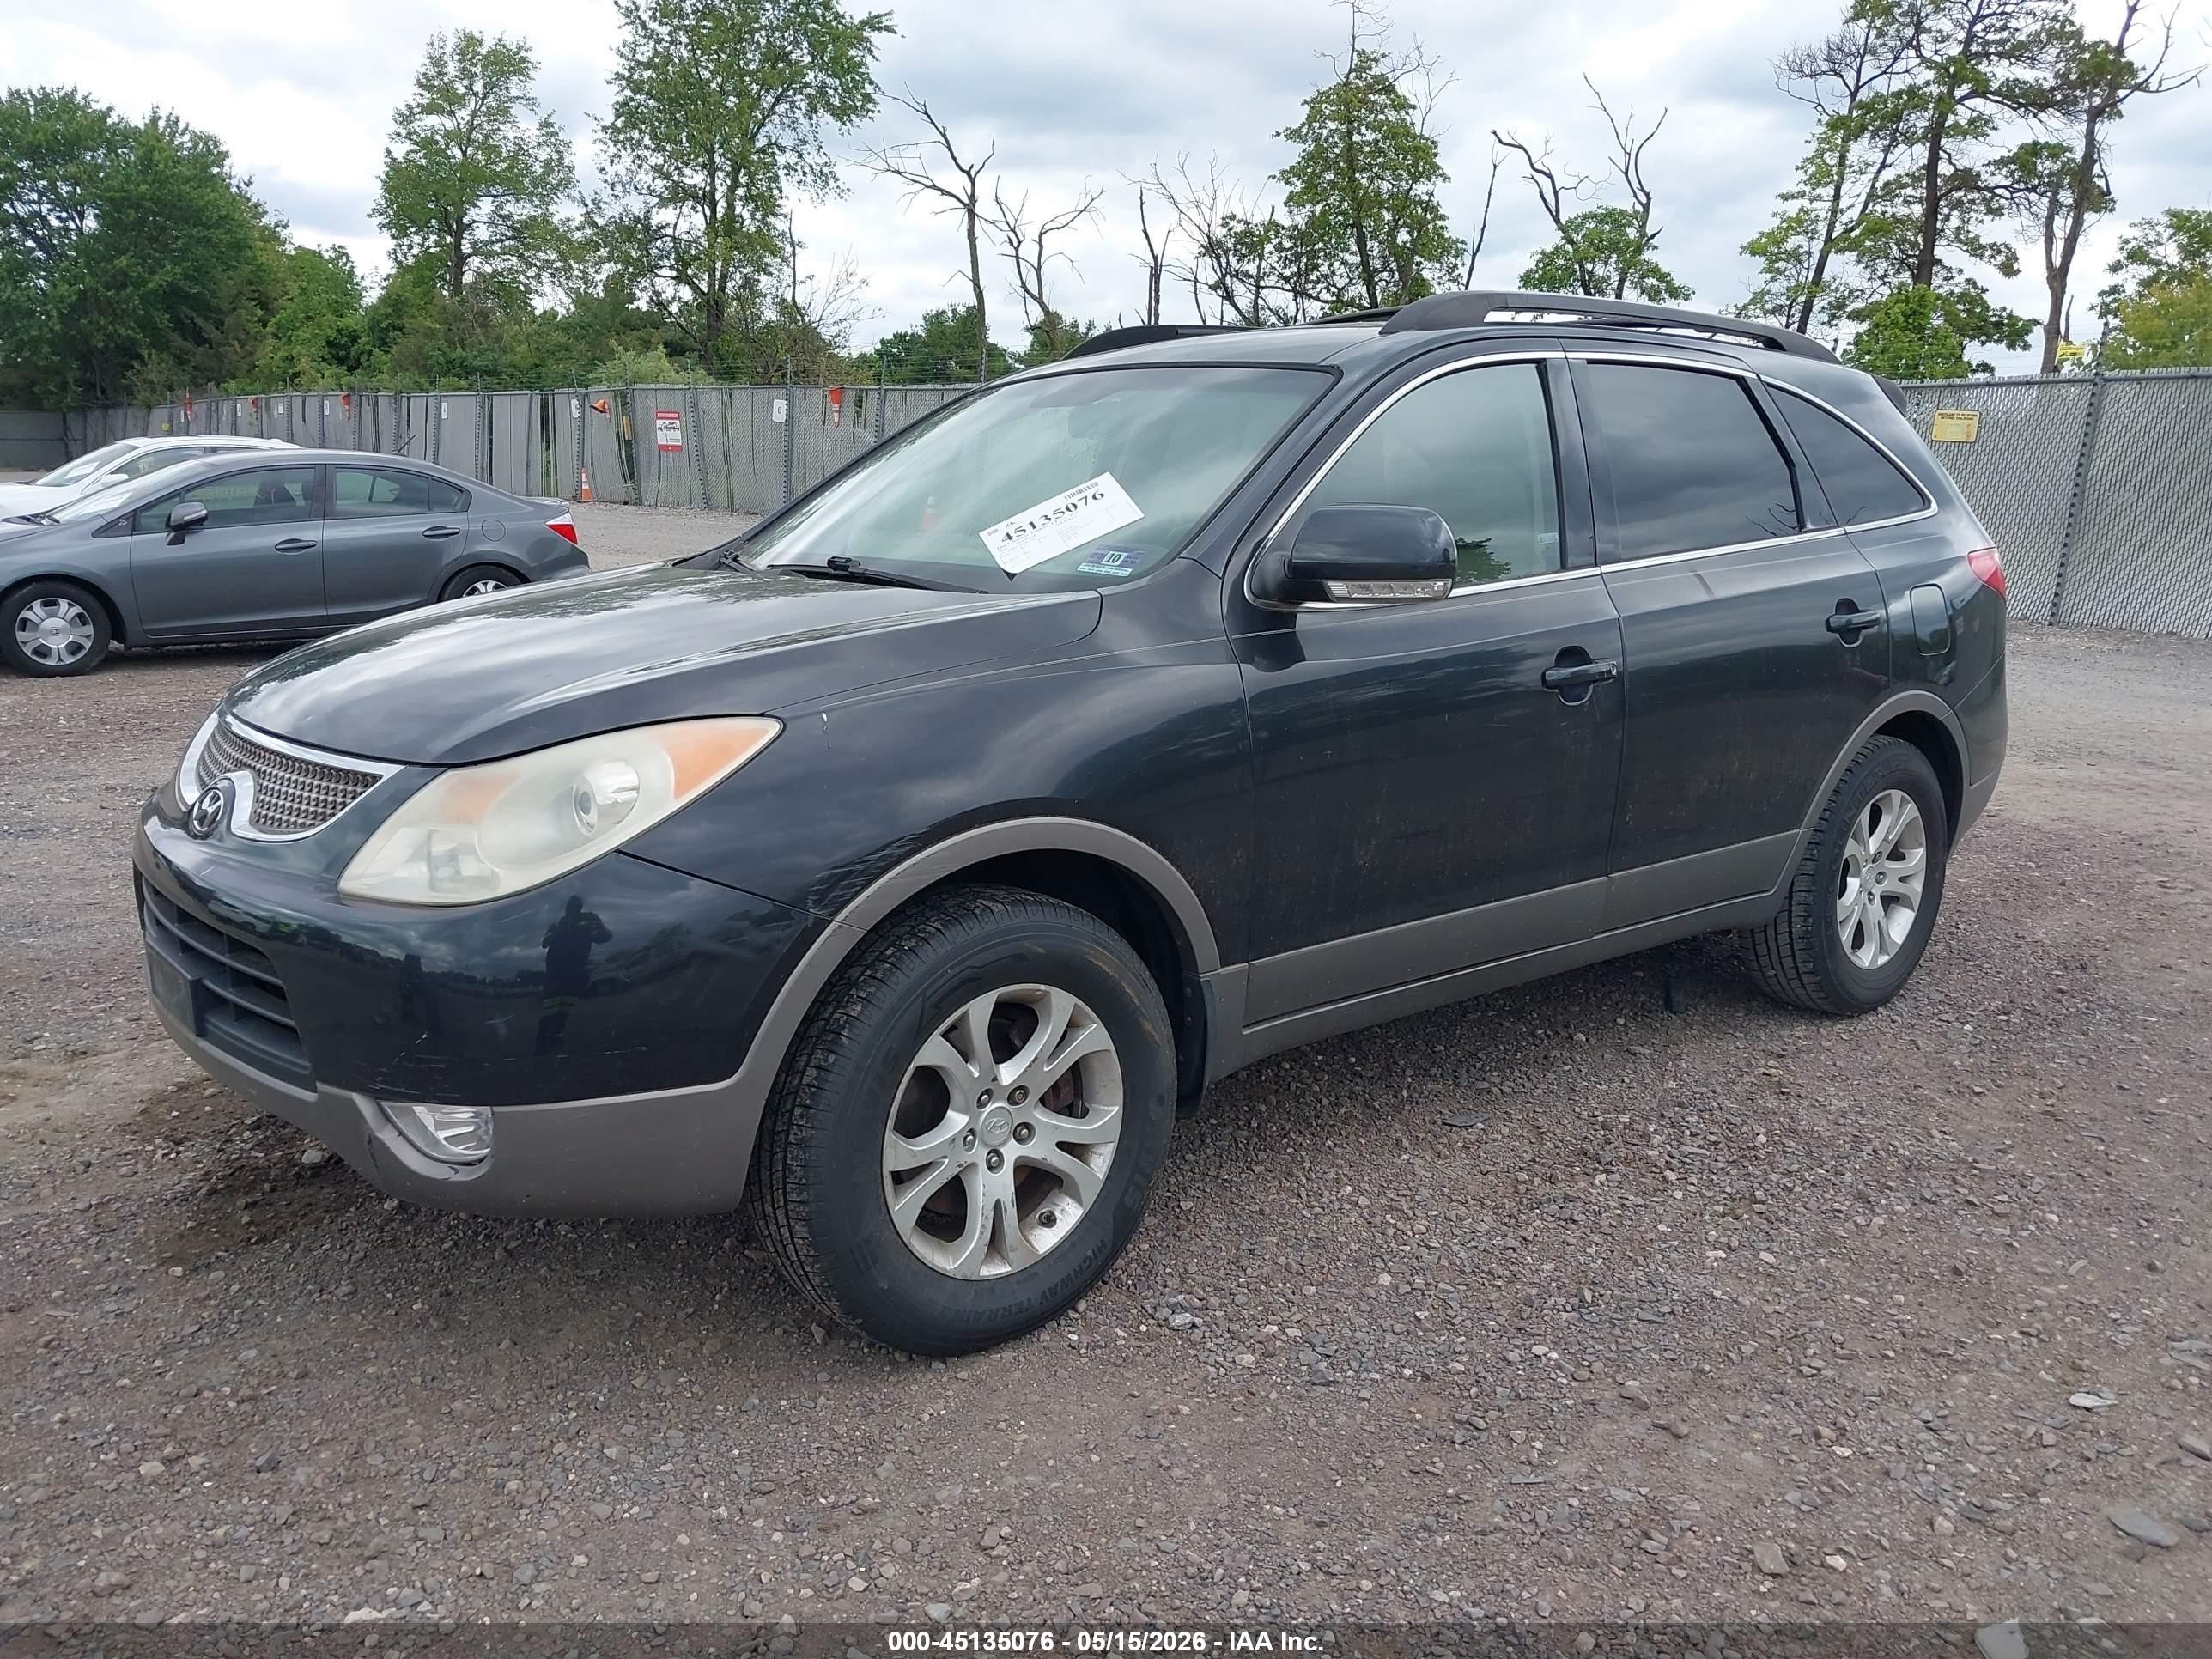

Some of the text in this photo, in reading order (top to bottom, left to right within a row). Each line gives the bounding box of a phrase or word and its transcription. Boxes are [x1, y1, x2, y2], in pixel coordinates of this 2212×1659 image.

[777, 405, 782, 415] 6
[1001, 490, 1105, 542] 45135076
[1105, 553, 1122, 563] 10
[1036, 1237, 1108, 1306] HIGHWAY
